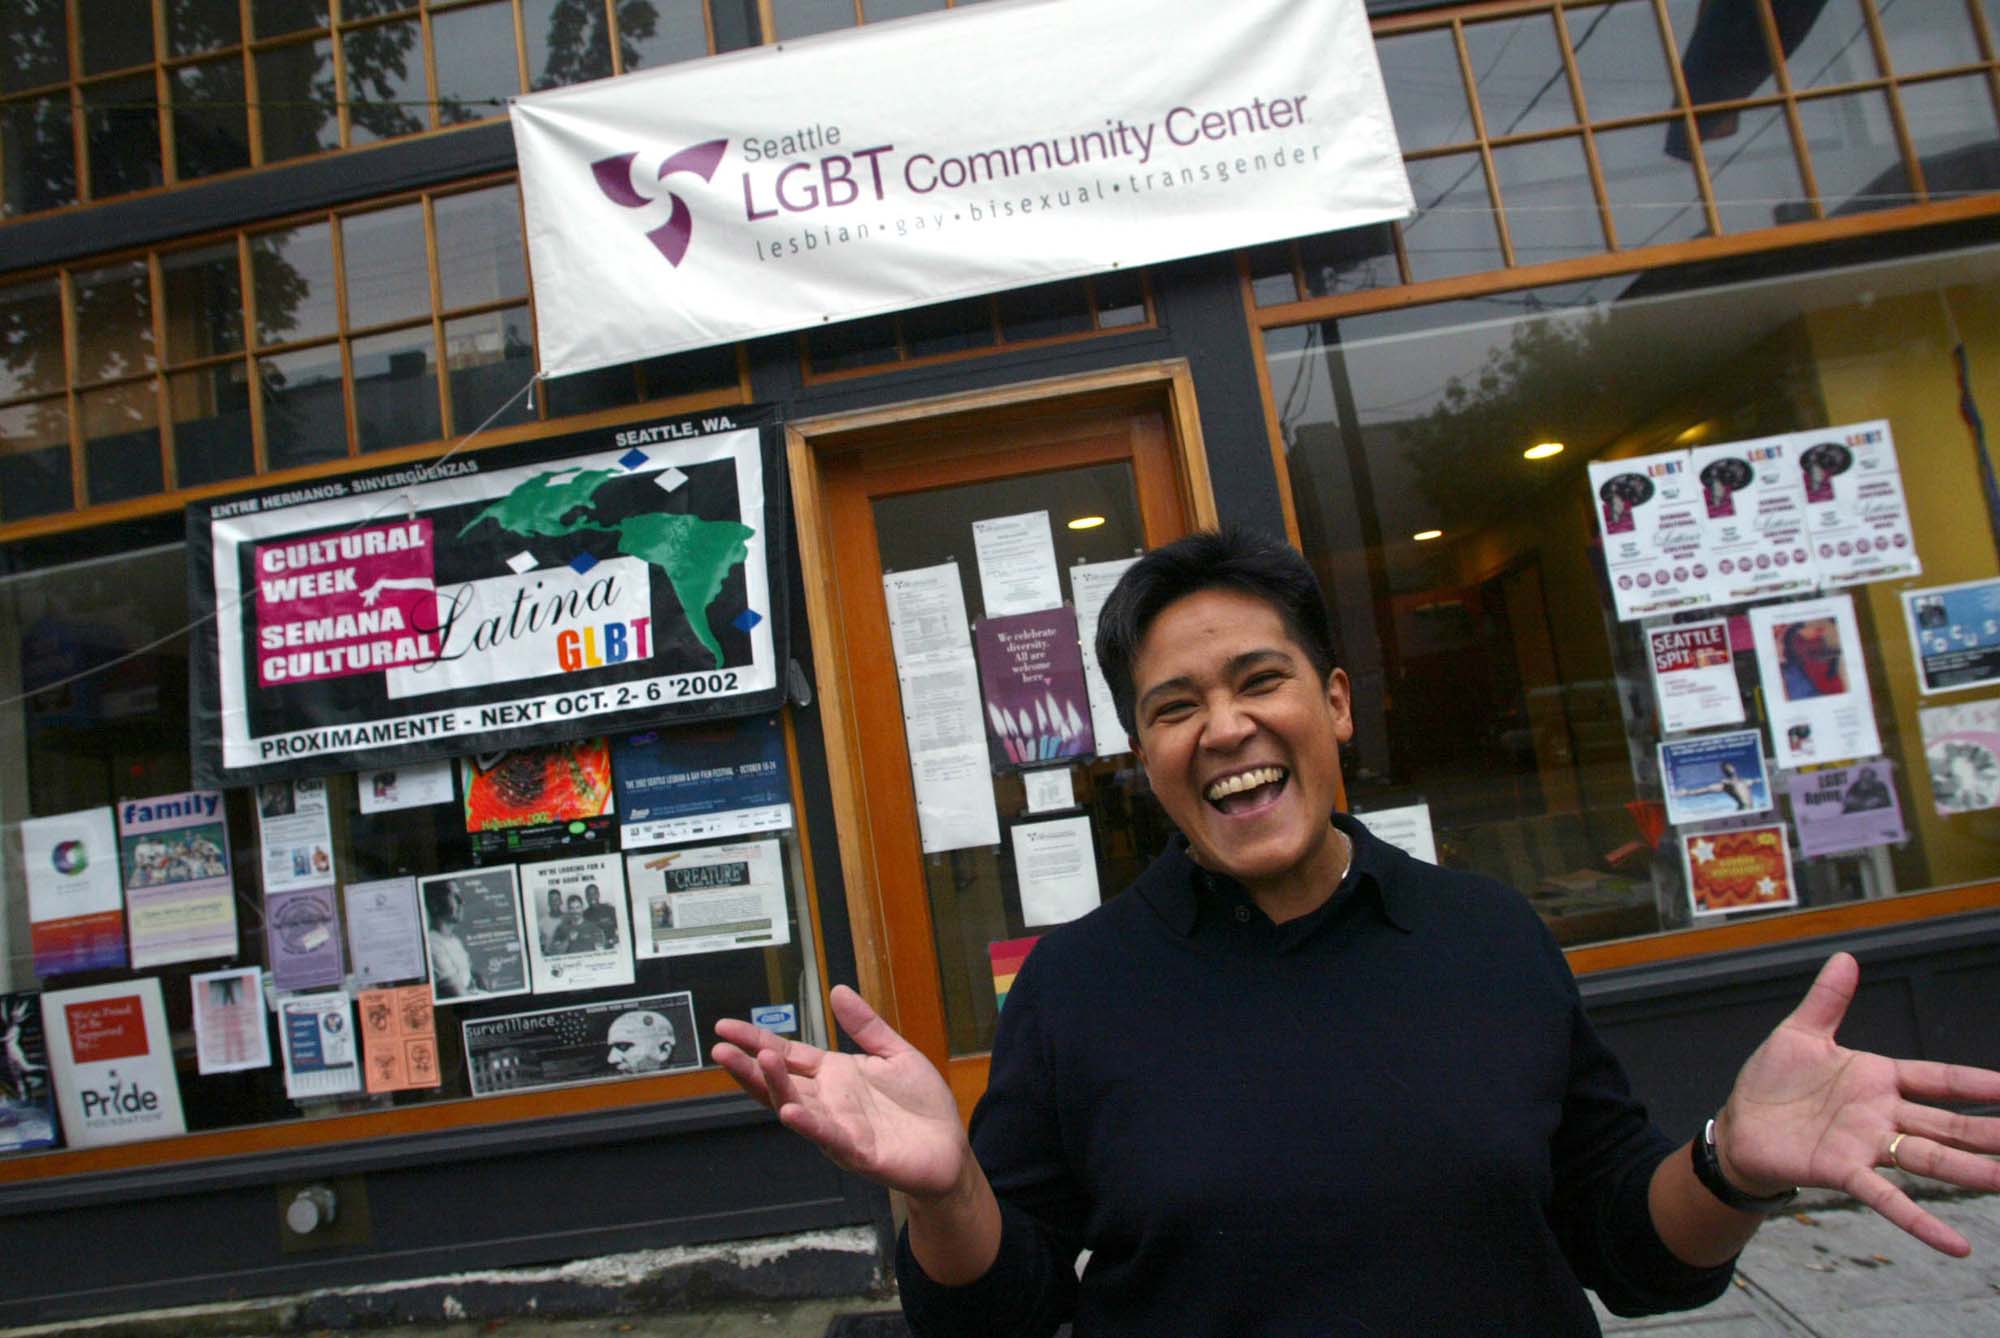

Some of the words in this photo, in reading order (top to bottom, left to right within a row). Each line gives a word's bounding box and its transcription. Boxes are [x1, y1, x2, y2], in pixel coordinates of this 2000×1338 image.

[742, 144, 894, 222] LGBT
[904, 119, 1155, 195] Community
[1165, 93, 1308, 147] Center
[743, 124, 841, 162] Seattle
[757, 224, 870, 261] lesbian
[897, 213, 944, 237] gay
[969, 180, 1103, 222] bisexual
[1130, 143, 1320, 193] transgender
[616, 421, 700, 447] SEATTLE,
[703, 416, 737, 433] WA.
[210, 500, 259, 519] ENTRE
[262, 525, 425, 573] CULTURAL
[261, 567, 358, 604] WEEK
[261, 607, 405, 650] SEMANA
[411, 575, 622, 673] Latina
[556, 617, 651, 673] GLBT
[1654, 626, 1722, 653] SEATTLE
[262, 635, 438, 682] CULTURAL
[1656, 649, 1690, 670] SPIT
[260, 714, 456, 760] PROXIMAMENTE
[481, 701, 547, 728] NEXT
[555, 692, 609, 717] OCT.
[669, 672, 739, 698] '2002
[123, 793, 219, 825] family
[466, 1015, 555, 1039] surveillance
[80, 1069, 158, 1118] Pride
